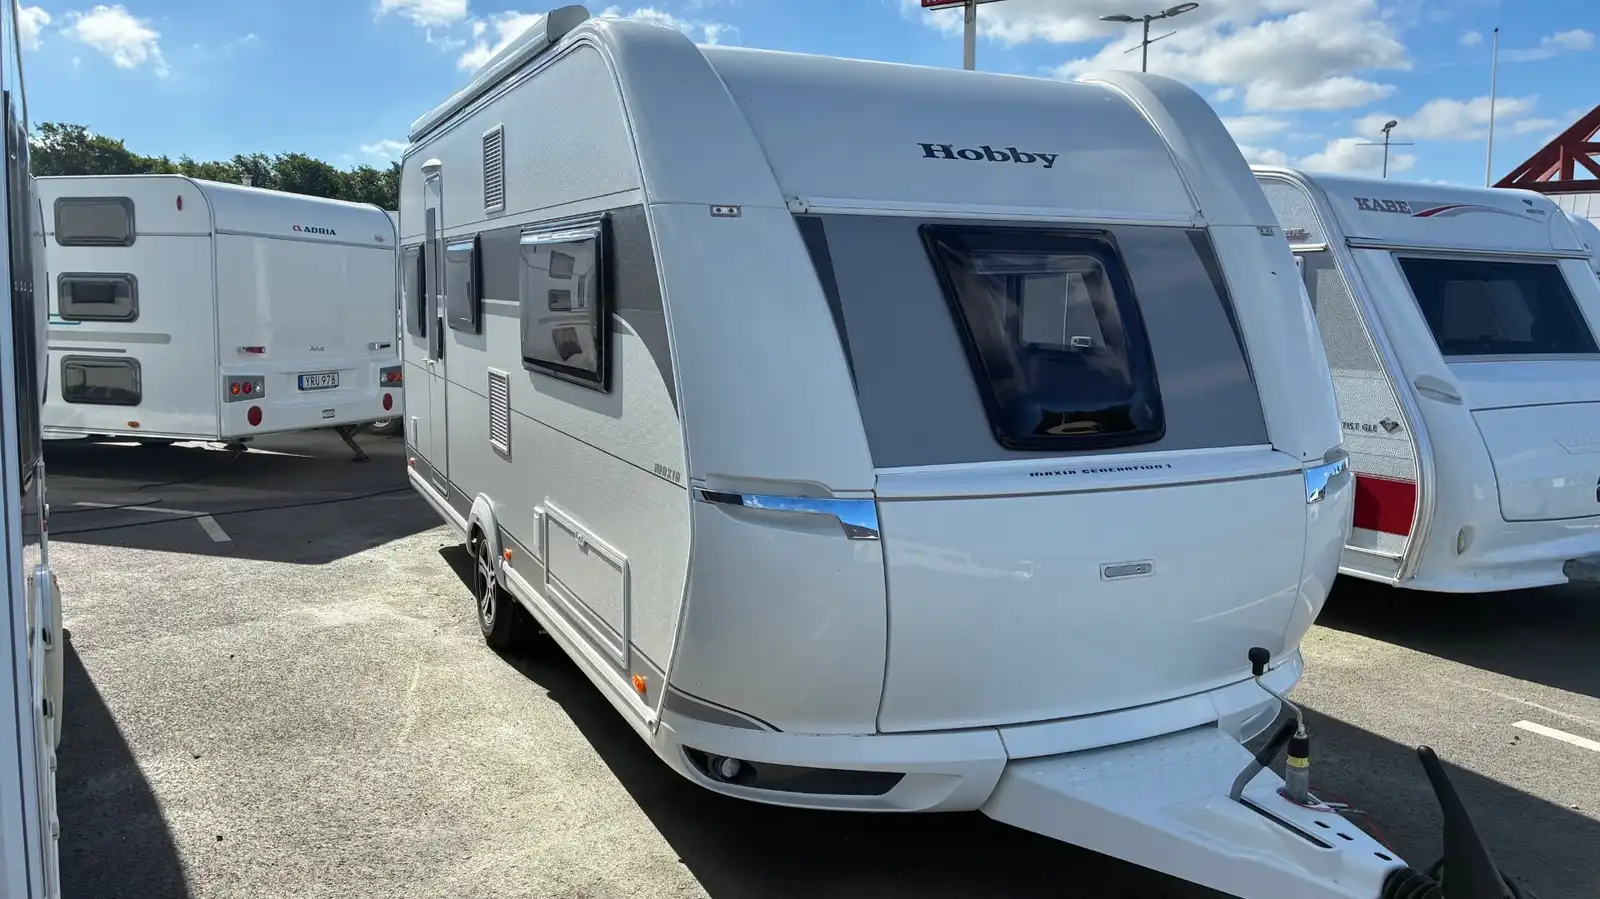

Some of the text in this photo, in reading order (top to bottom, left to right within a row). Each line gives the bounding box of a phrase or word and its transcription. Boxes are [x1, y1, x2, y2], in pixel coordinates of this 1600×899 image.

[917, 142, 1059, 169] Hobby
[1353, 196, 1412, 215] KABE
[303, 226, 337, 236] ADRIA
[305, 374, 336, 387] YRU 978
[1081, 464, 1163, 474] GENERATION
